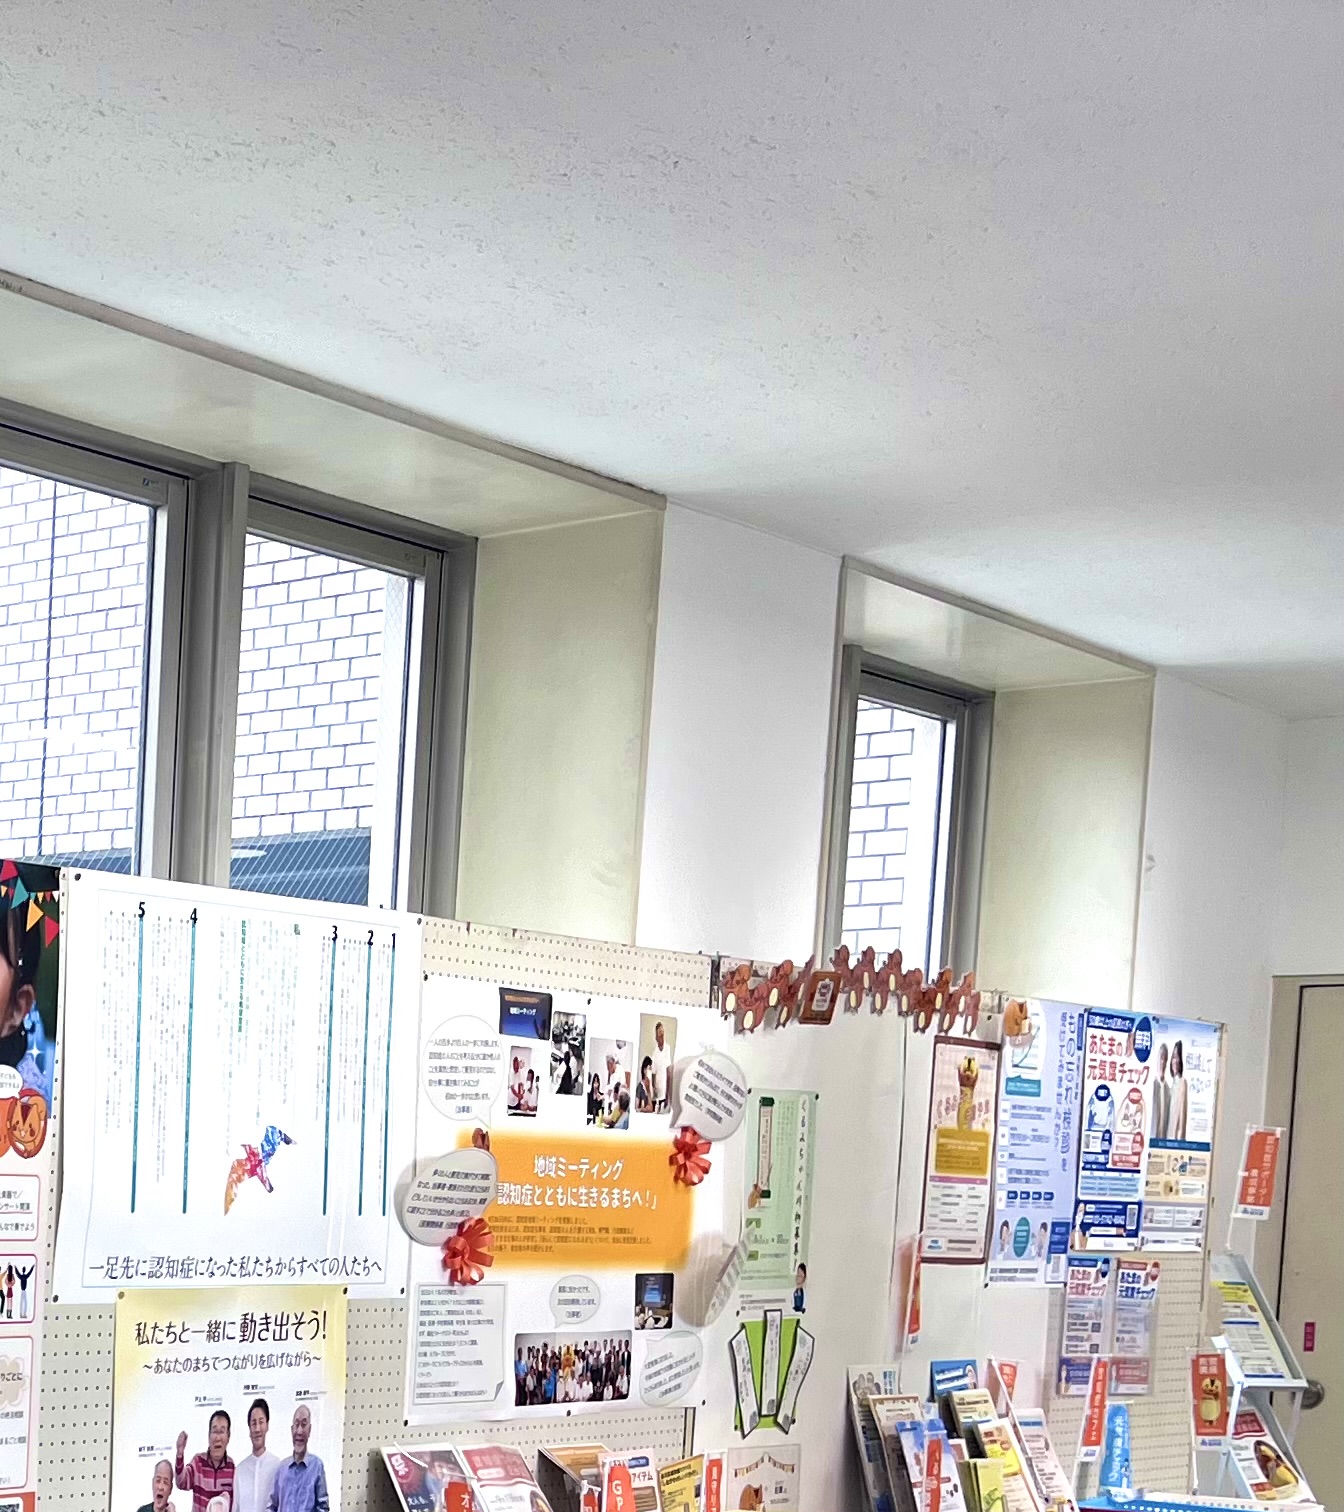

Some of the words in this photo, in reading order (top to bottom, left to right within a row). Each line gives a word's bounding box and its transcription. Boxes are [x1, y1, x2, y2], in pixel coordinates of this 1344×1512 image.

[138, 901, 146, 918] 5
[189, 907, 198, 924] 4
[331, 925, 338, 942] 3
[367, 930, 374, 946] 2
[391, 932, 396, 949] 1
[1088, 1033, 1123, 1057] あたまの
[1087, 1058, 1150, 1085] 元気度チェック
[534, 1154, 625, 1180] 地域ミーティング
[89, 1255, 382, 1280] 一足先に認知症になった私たちからすべての人たちへ
[134, 1320, 236, 1346] 私たちと一緒に
[238, 1310, 327, 1344] 動き出そう!
